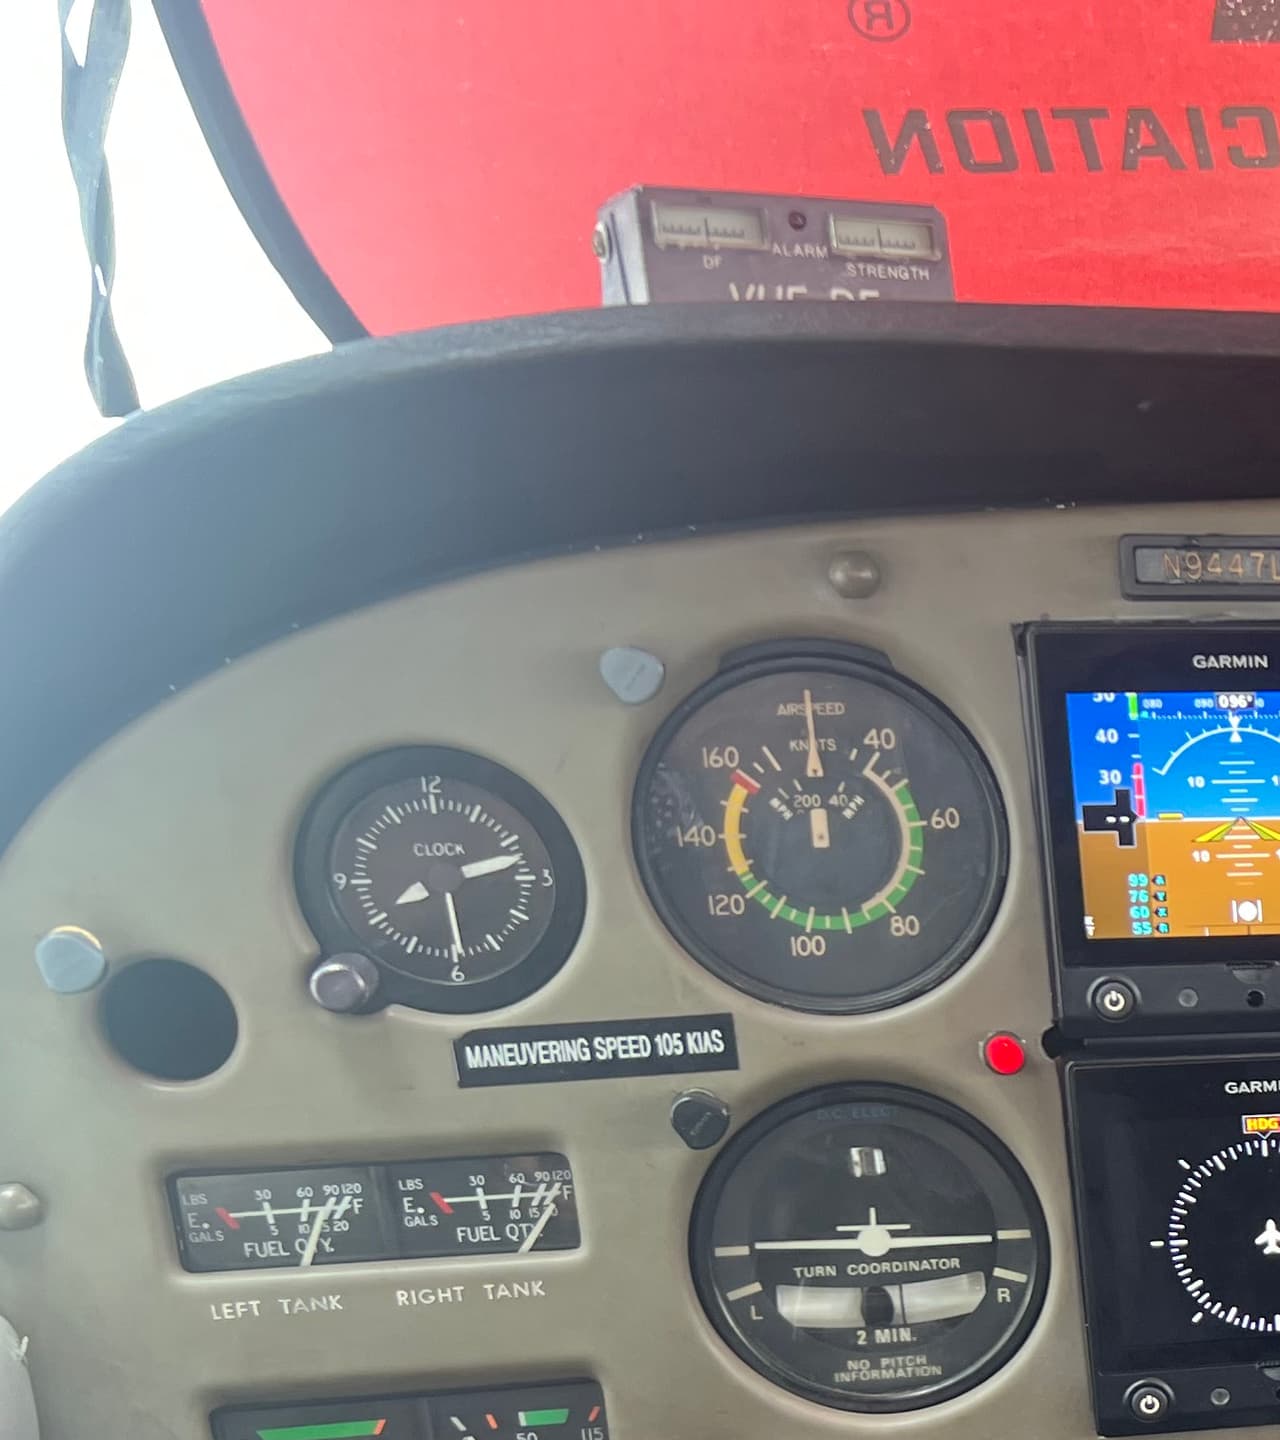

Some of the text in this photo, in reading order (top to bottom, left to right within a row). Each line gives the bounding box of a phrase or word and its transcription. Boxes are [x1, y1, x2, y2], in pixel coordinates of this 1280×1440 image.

[772, 242, 829, 260] ALARM
[702, 254, 723, 269] DF
[846, 262, 931, 281] STRENGTH
[1192, 654, 1268, 669] GARMIN
[864, 728, 895, 750] 40
[703, 746, 739, 768] 160
[421, 775, 442, 793] 12
[413, 843, 465, 857] CLOCK
[708, 894, 745, 916] 120
[790, 936, 826, 957] 100
[466, 1030, 724, 1070] MANEUVERING SPEED 105 KIAS
[1246, 1117, 1279, 1131] HDG
[457, 1227, 500, 1242] FUEL
[794, 1258, 960, 1279] TURN COORDINATOR
[396, 1281, 546, 1306] RIGHT TANK
[210, 1296, 344, 1320] LEFT TANK
[857, 1328, 917, 1345] 2 MIN.
[848, 1354, 927, 1372] NO PITCH
[834, 1366, 943, 1383] INFORMATION
